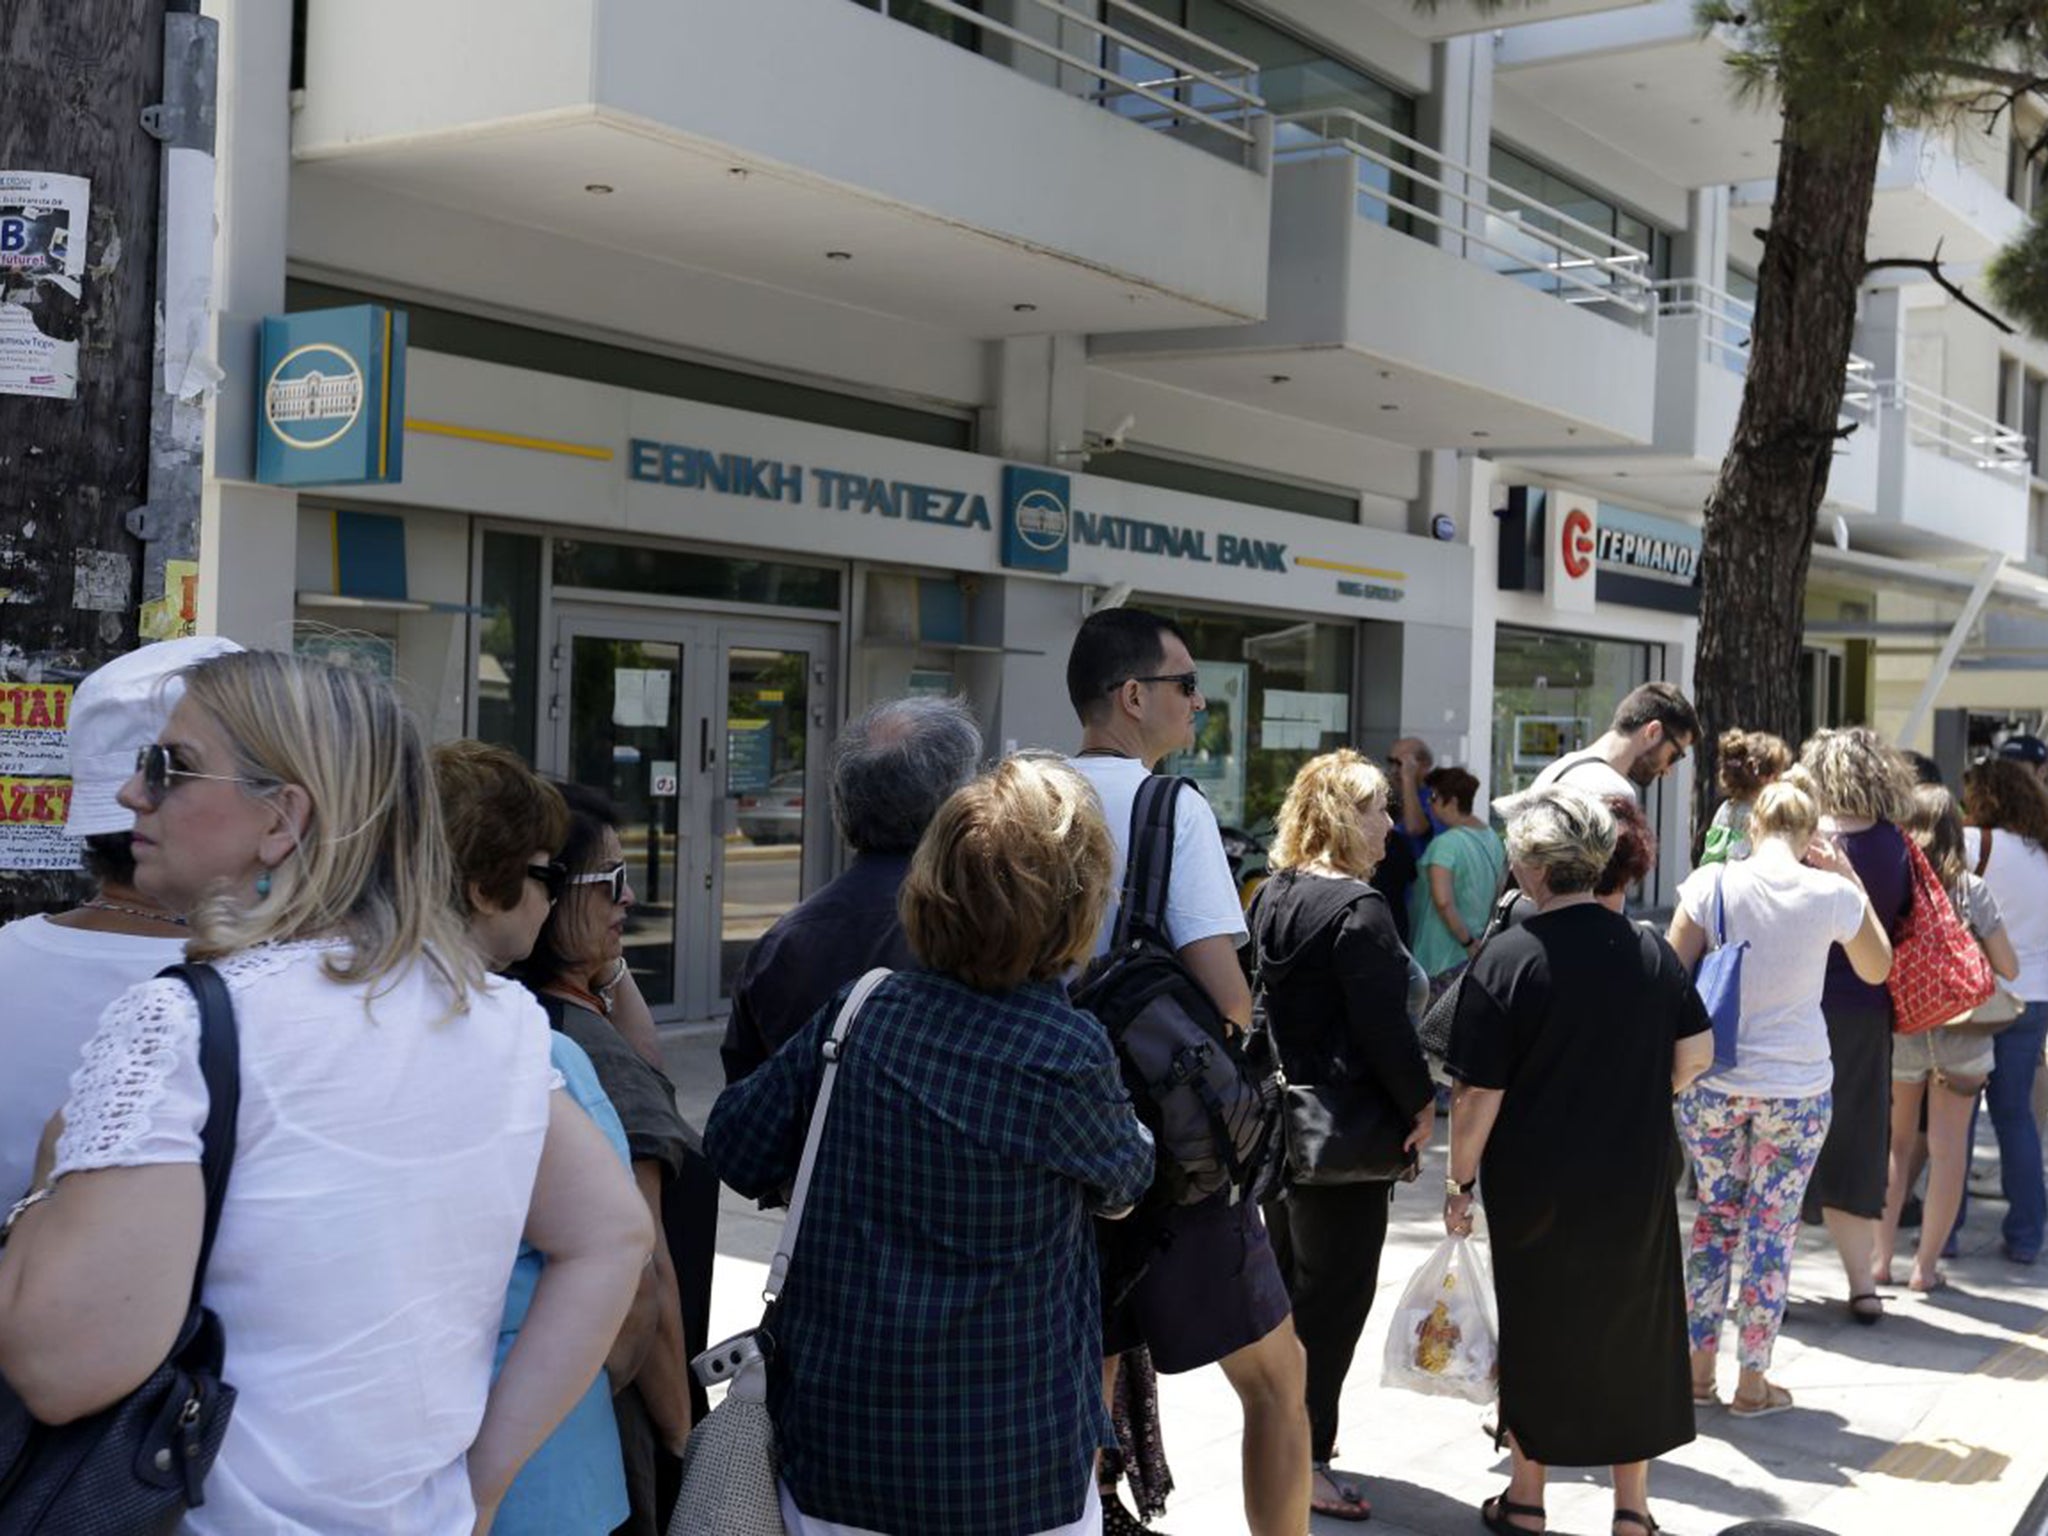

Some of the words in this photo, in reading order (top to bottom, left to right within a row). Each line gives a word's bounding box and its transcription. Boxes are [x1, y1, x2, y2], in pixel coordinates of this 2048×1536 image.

[629, 438, 802, 504] ΕΘΝΙΚΗ
[810, 467, 992, 531] ΤΡΑΠΕΖΑ
[1073, 510, 1211, 562] NATIONAL
[1217, 533, 1288, 573] BANK
